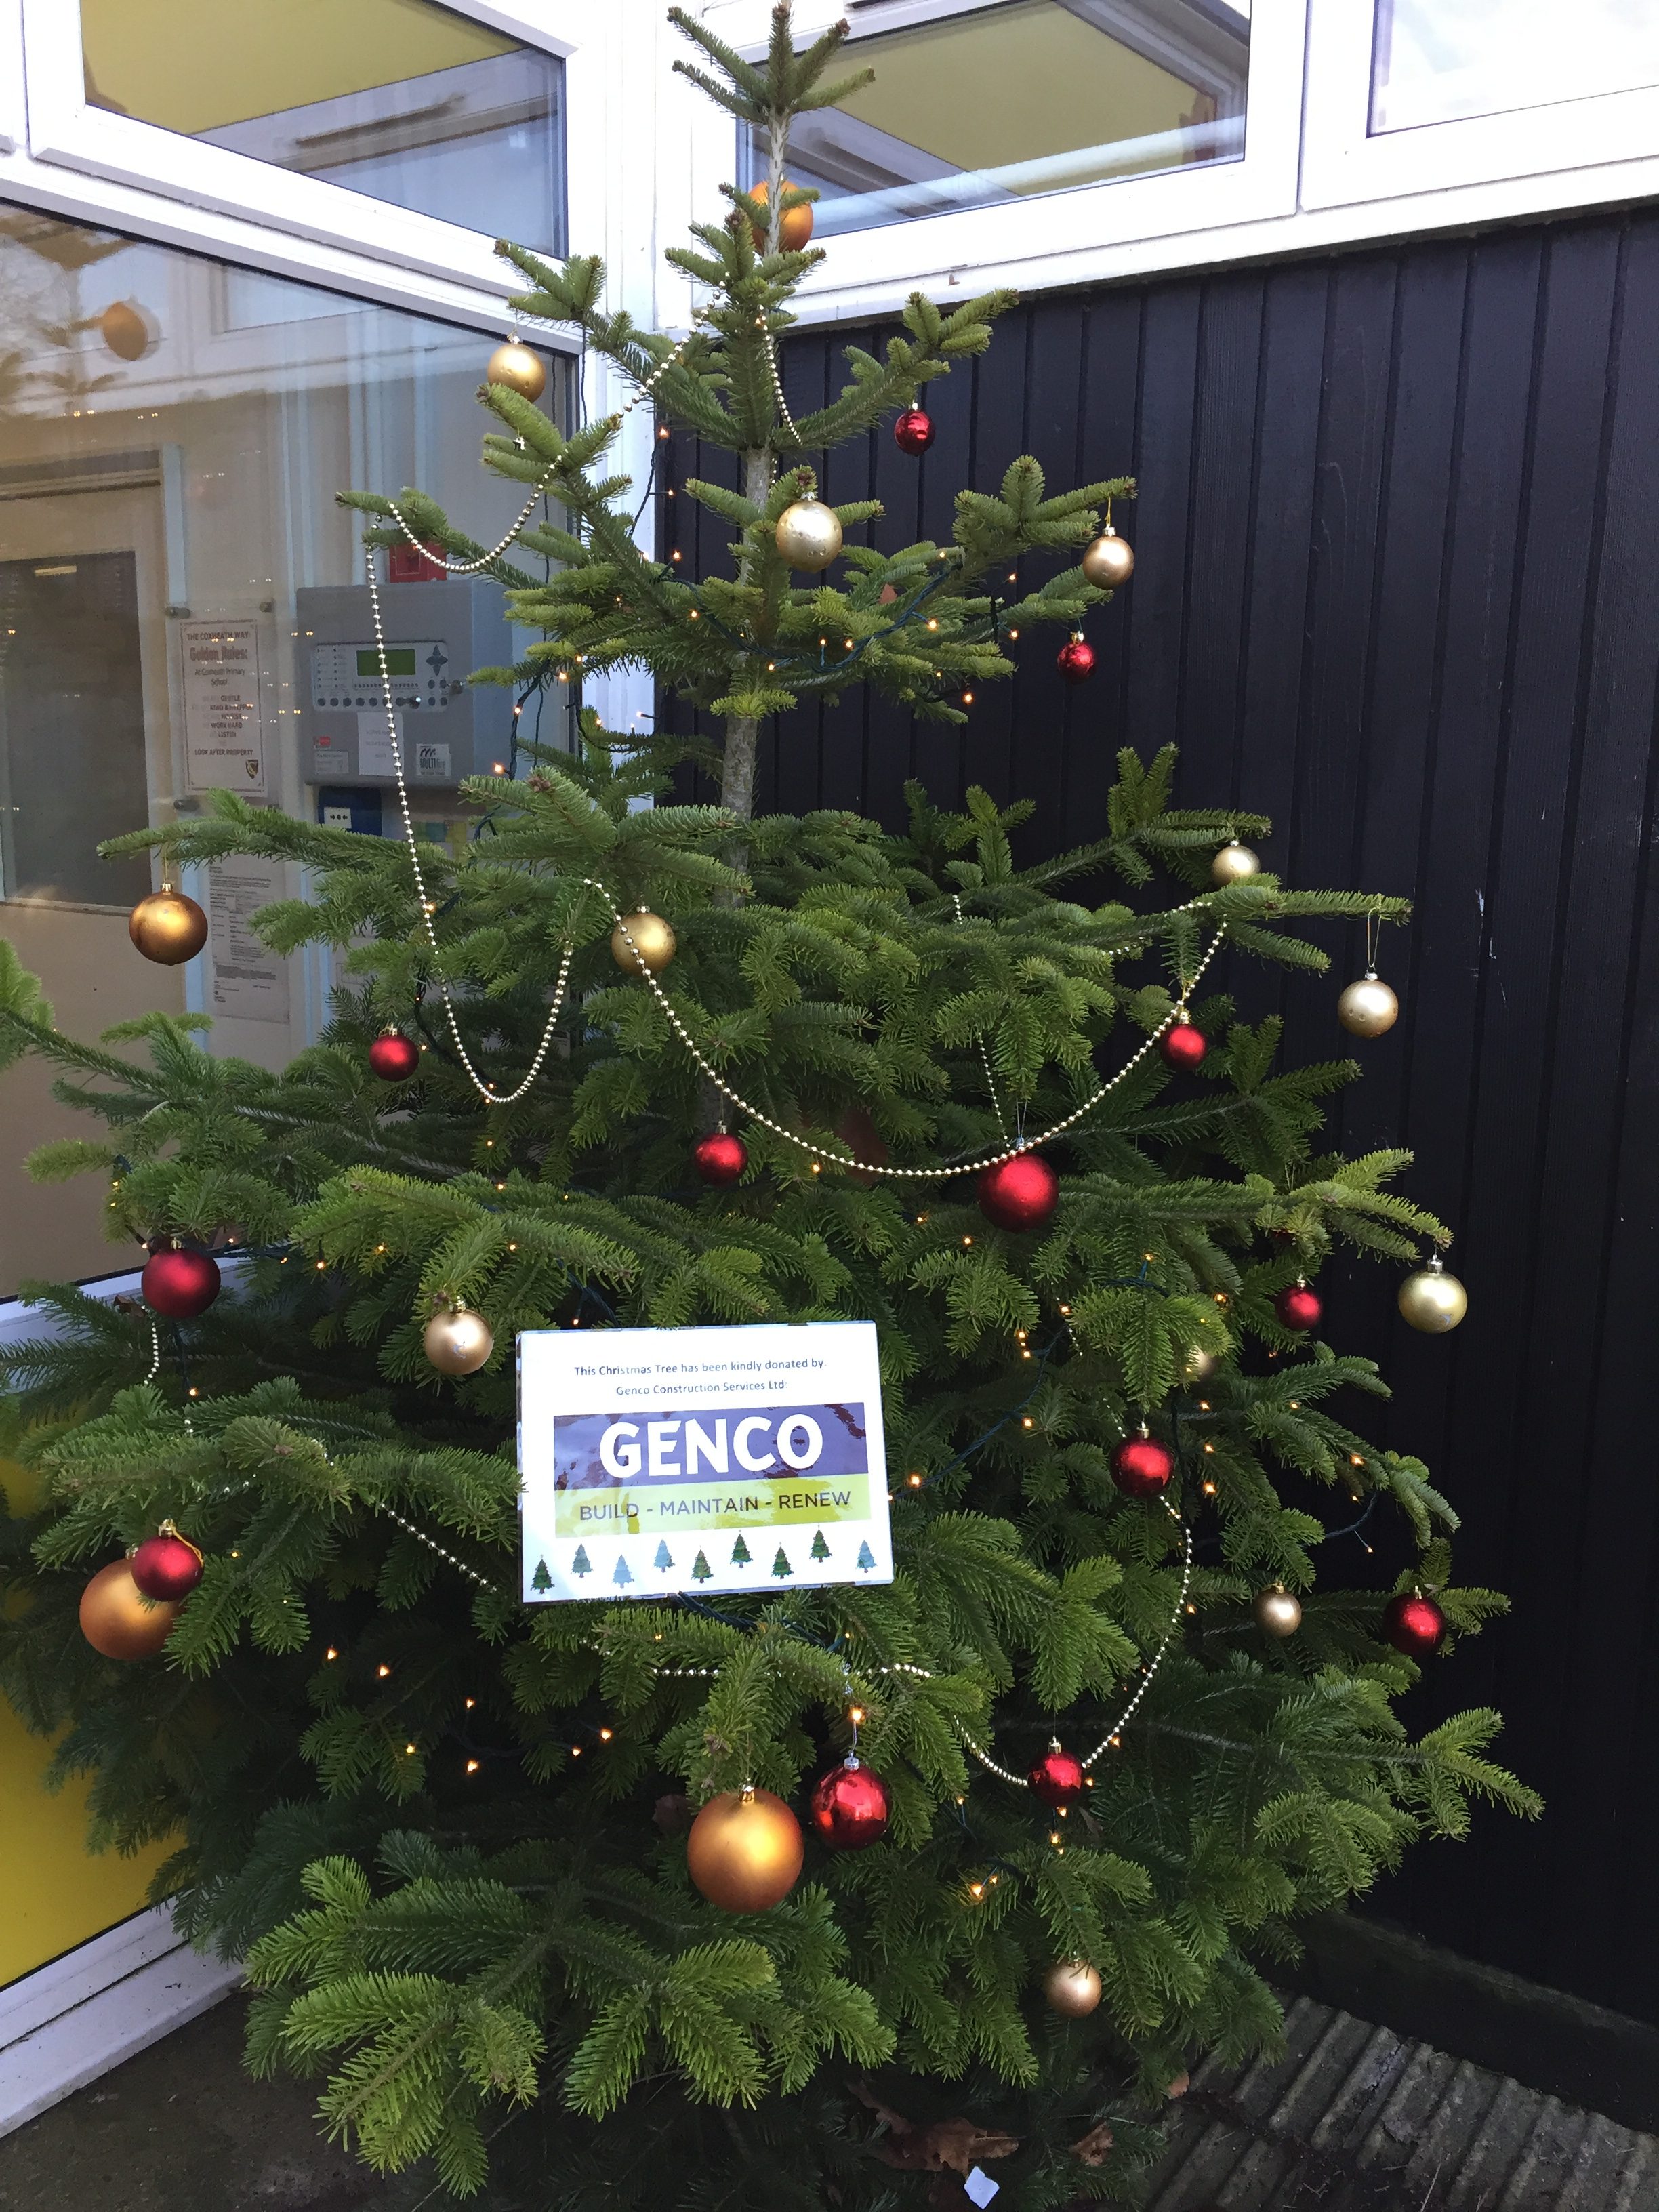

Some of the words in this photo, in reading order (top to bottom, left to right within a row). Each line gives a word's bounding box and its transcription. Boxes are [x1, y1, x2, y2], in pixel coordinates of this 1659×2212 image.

[190, 646, 219, 661] Golden
[222, 646, 248, 661] Rules:
[574, 1366, 596, 1376] This
[598, 1365, 652, 1375] Christmas
[655, 1364, 678, 1373] Tree
[680, 1363, 699, 1372] has
[702, 1362, 728, 1372] been
[731, 1361, 762, 1372] kindly
[764, 1359, 808, 1370] donated
[616, 1386, 650, 1395] Genco
[653, 1384, 720, 1394] Construction
[723, 1382, 765, 1391] Services
[599, 1413, 823, 1479] GENCO
[579, 1502, 640, 1521] BUILD
[660, 1496, 759, 1516] MAINTAIN
[778, 1490, 851, 1509] RENEW
